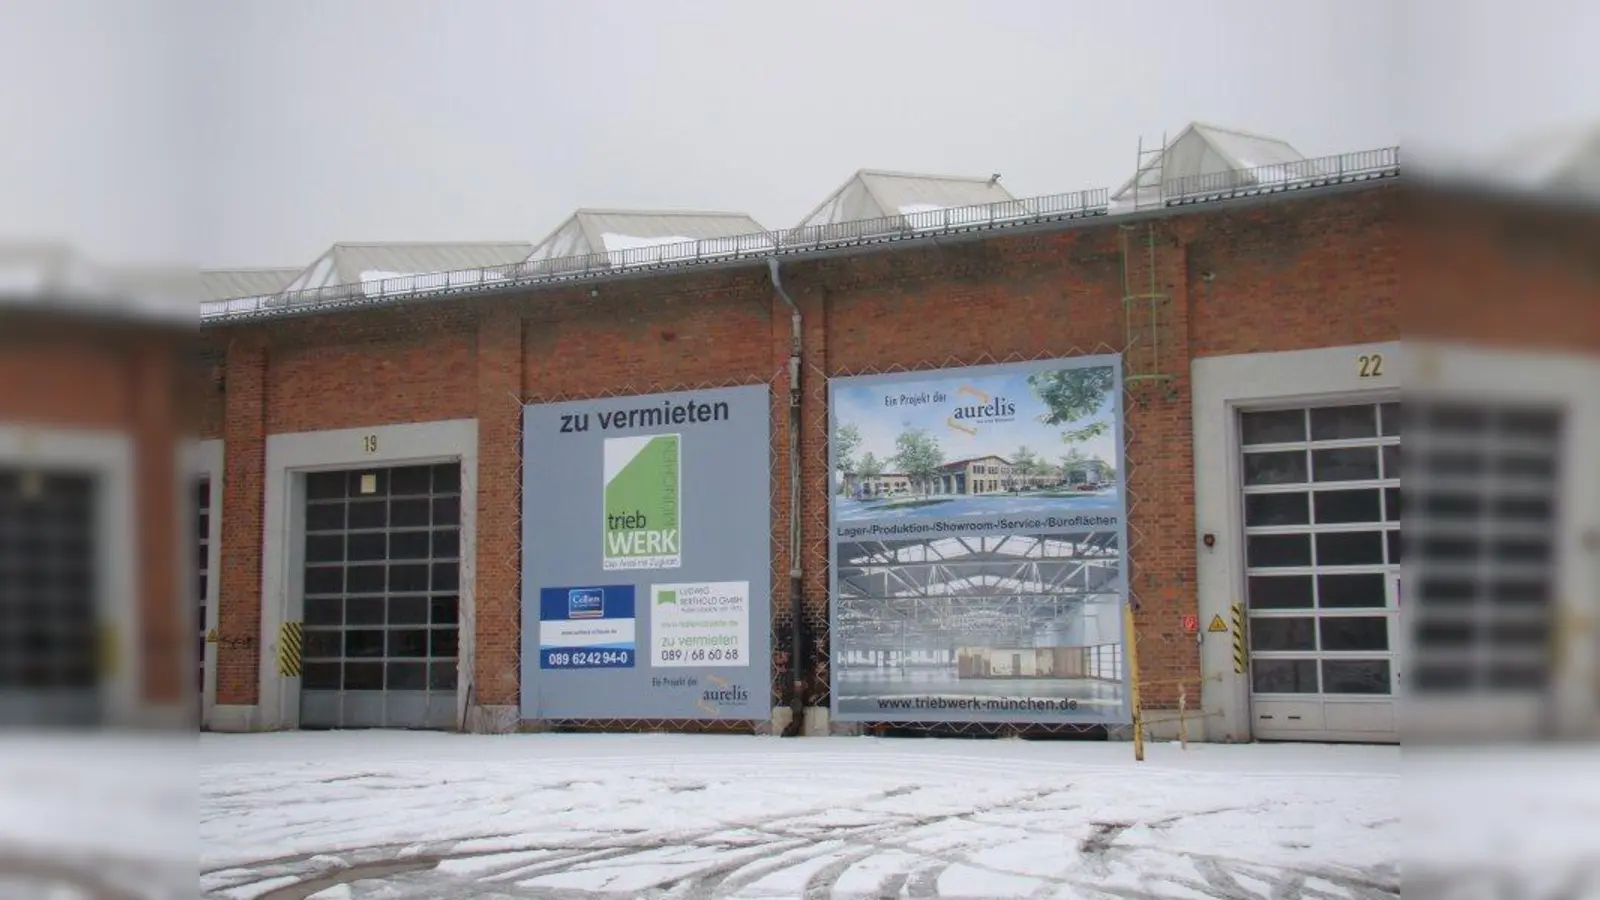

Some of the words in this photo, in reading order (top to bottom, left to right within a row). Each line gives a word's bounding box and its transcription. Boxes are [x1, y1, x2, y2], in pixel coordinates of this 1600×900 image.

[1359, 354, 1383, 377] 22
[884, 395, 898, 407] Ein
[900, 391, 930, 406] Projekt
[933, 390, 946, 403] der
[954, 396, 1016, 419] aurelis
[559, 413, 589, 433] zu
[598, 400, 729, 430] vermieten
[363, 434, 377, 452] 19
[608, 510, 647, 530] trieb
[608, 529, 677, 555] WERK
[661, 637, 675, 648] zu
[678, 634, 738, 646] vermieten
[548, 652, 569, 665] 089
[661, 650, 682, 661] 089
[691, 649, 705, 661] 68
[708, 648, 722, 660] 60
[724, 648, 739, 660] 68
[703, 684, 748, 701] aurelis
[877, 696, 1078, 712] www.triebwerk-münchen.de
